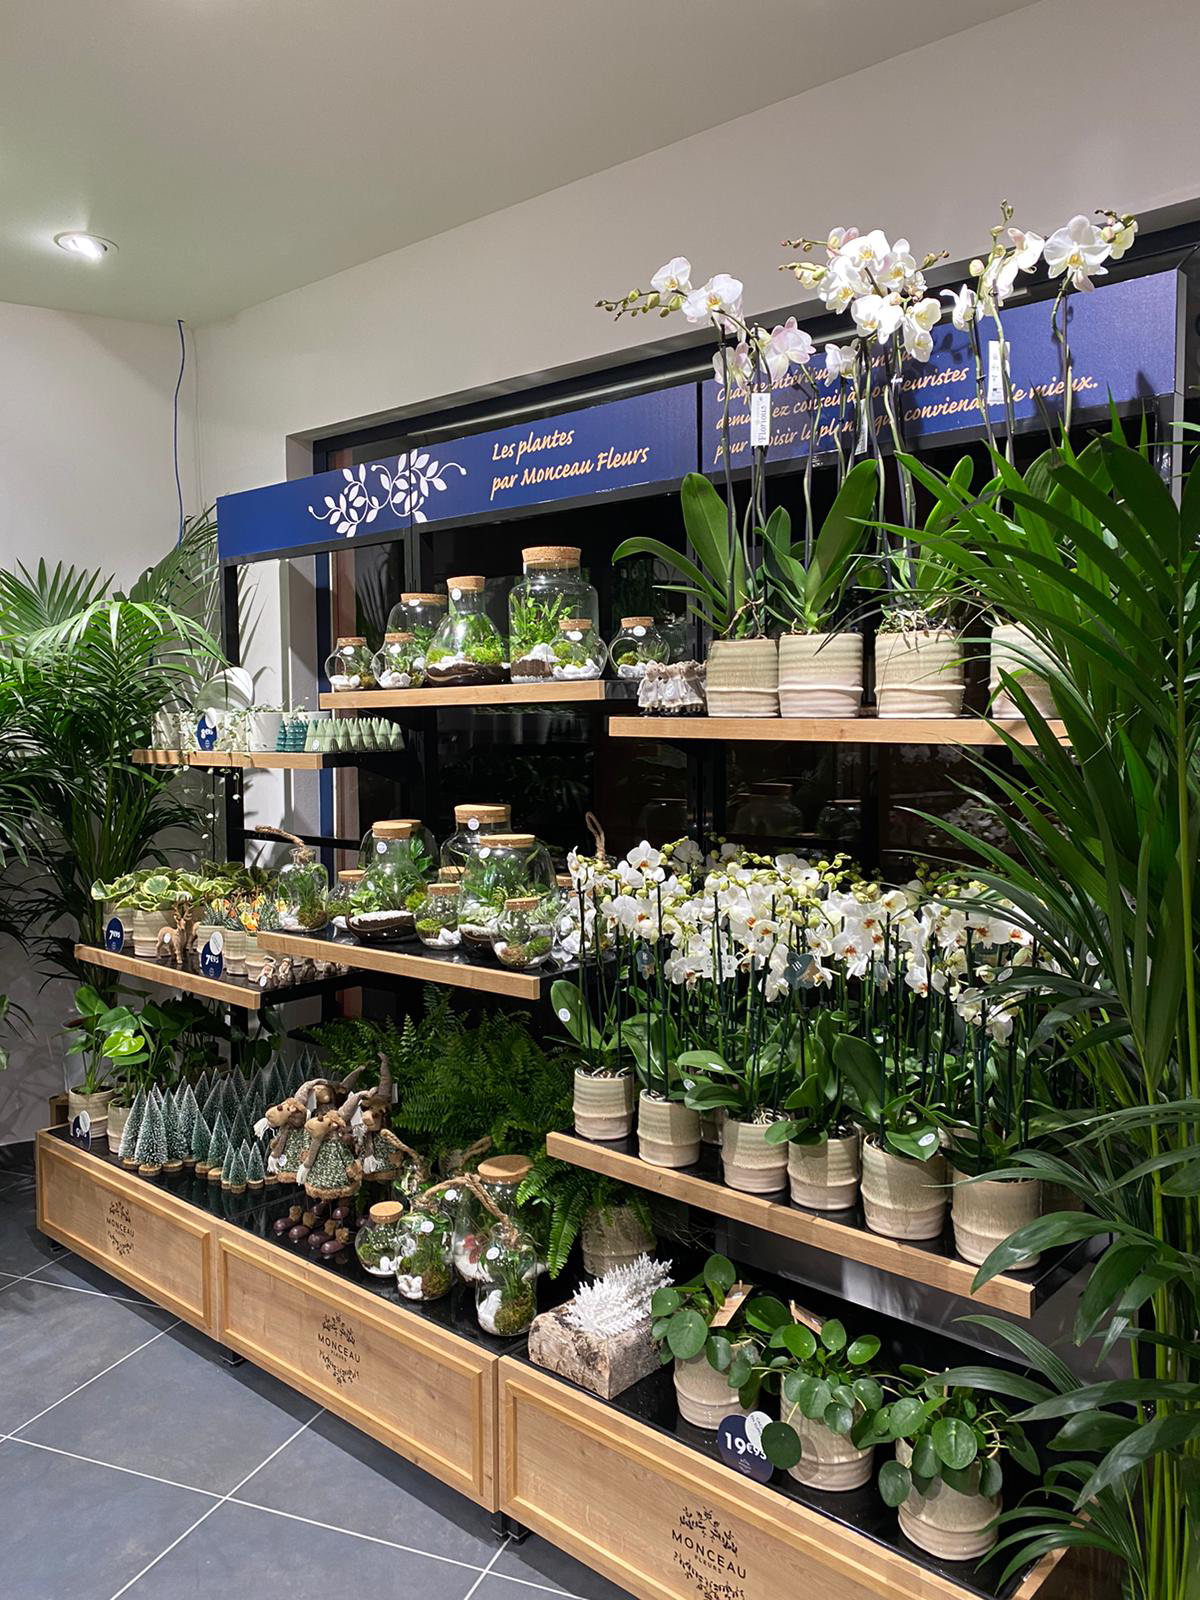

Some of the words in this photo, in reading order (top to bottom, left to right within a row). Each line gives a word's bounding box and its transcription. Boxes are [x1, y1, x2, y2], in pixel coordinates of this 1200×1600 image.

[492, 444, 515, 461] Les
[516, 430, 575, 465] plantes
[490, 474, 517, 501] par
[520, 459, 594, 486] Monceau
[597, 447, 650, 471] Fleurs
[318, 1333, 361, 1363] MONCEAU
[672, 1529, 746, 1579] MONCEAU
